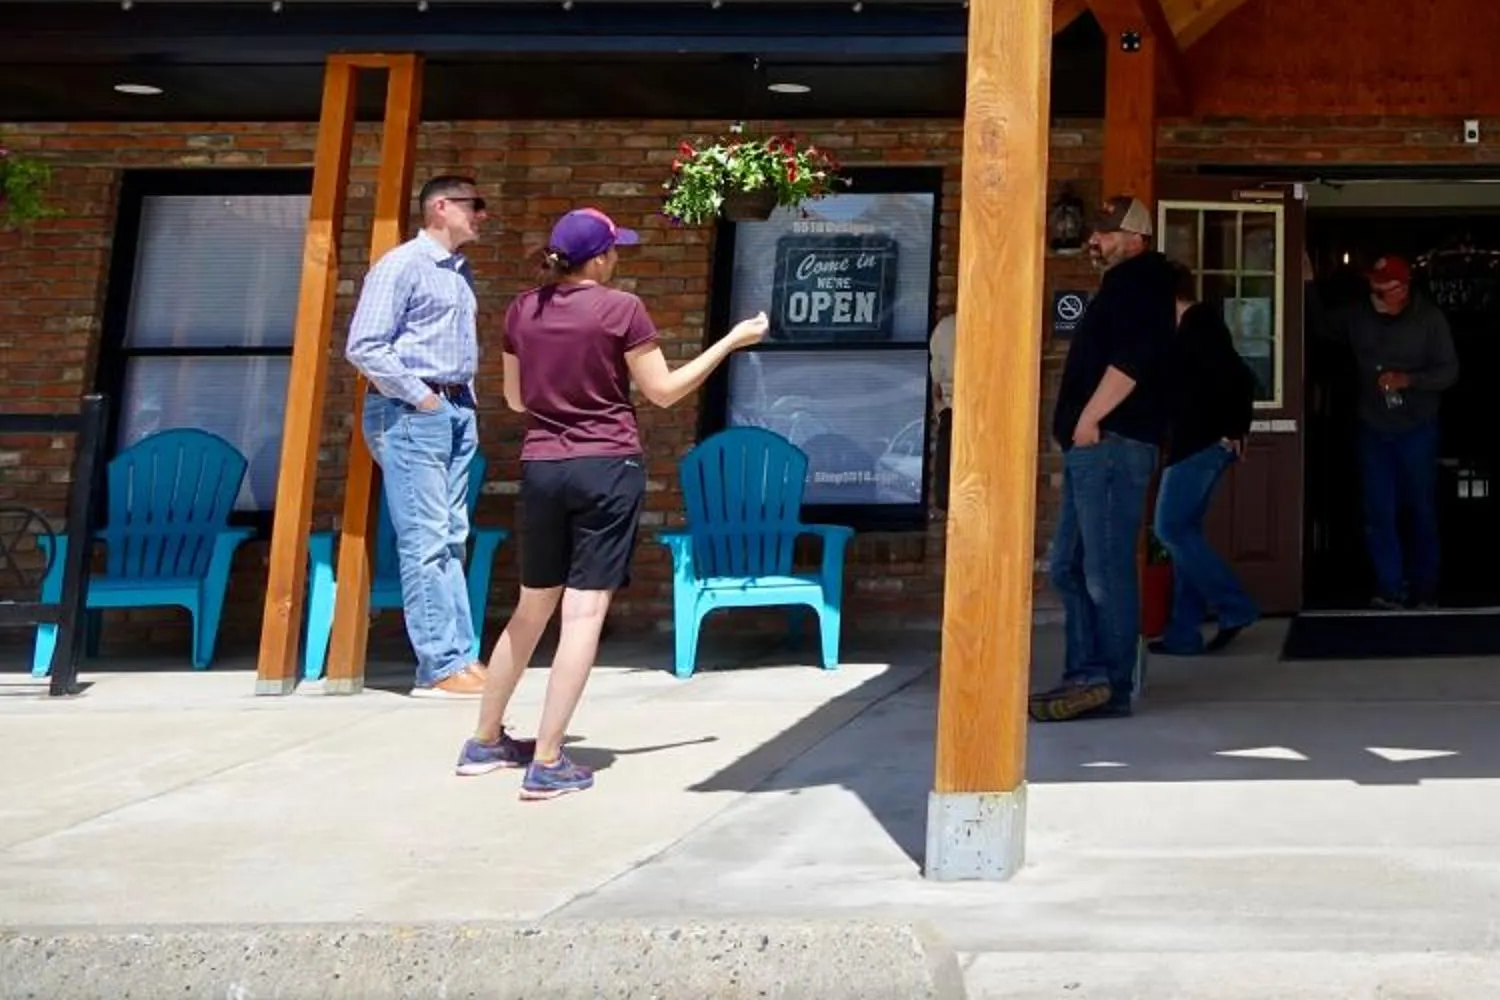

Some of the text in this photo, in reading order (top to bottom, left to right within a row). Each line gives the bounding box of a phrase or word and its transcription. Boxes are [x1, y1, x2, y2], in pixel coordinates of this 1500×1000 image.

[796, 252, 877, 280] Come in
[817, 277, 852, 289] WE'RE
[788, 291, 877, 324] OPEN
